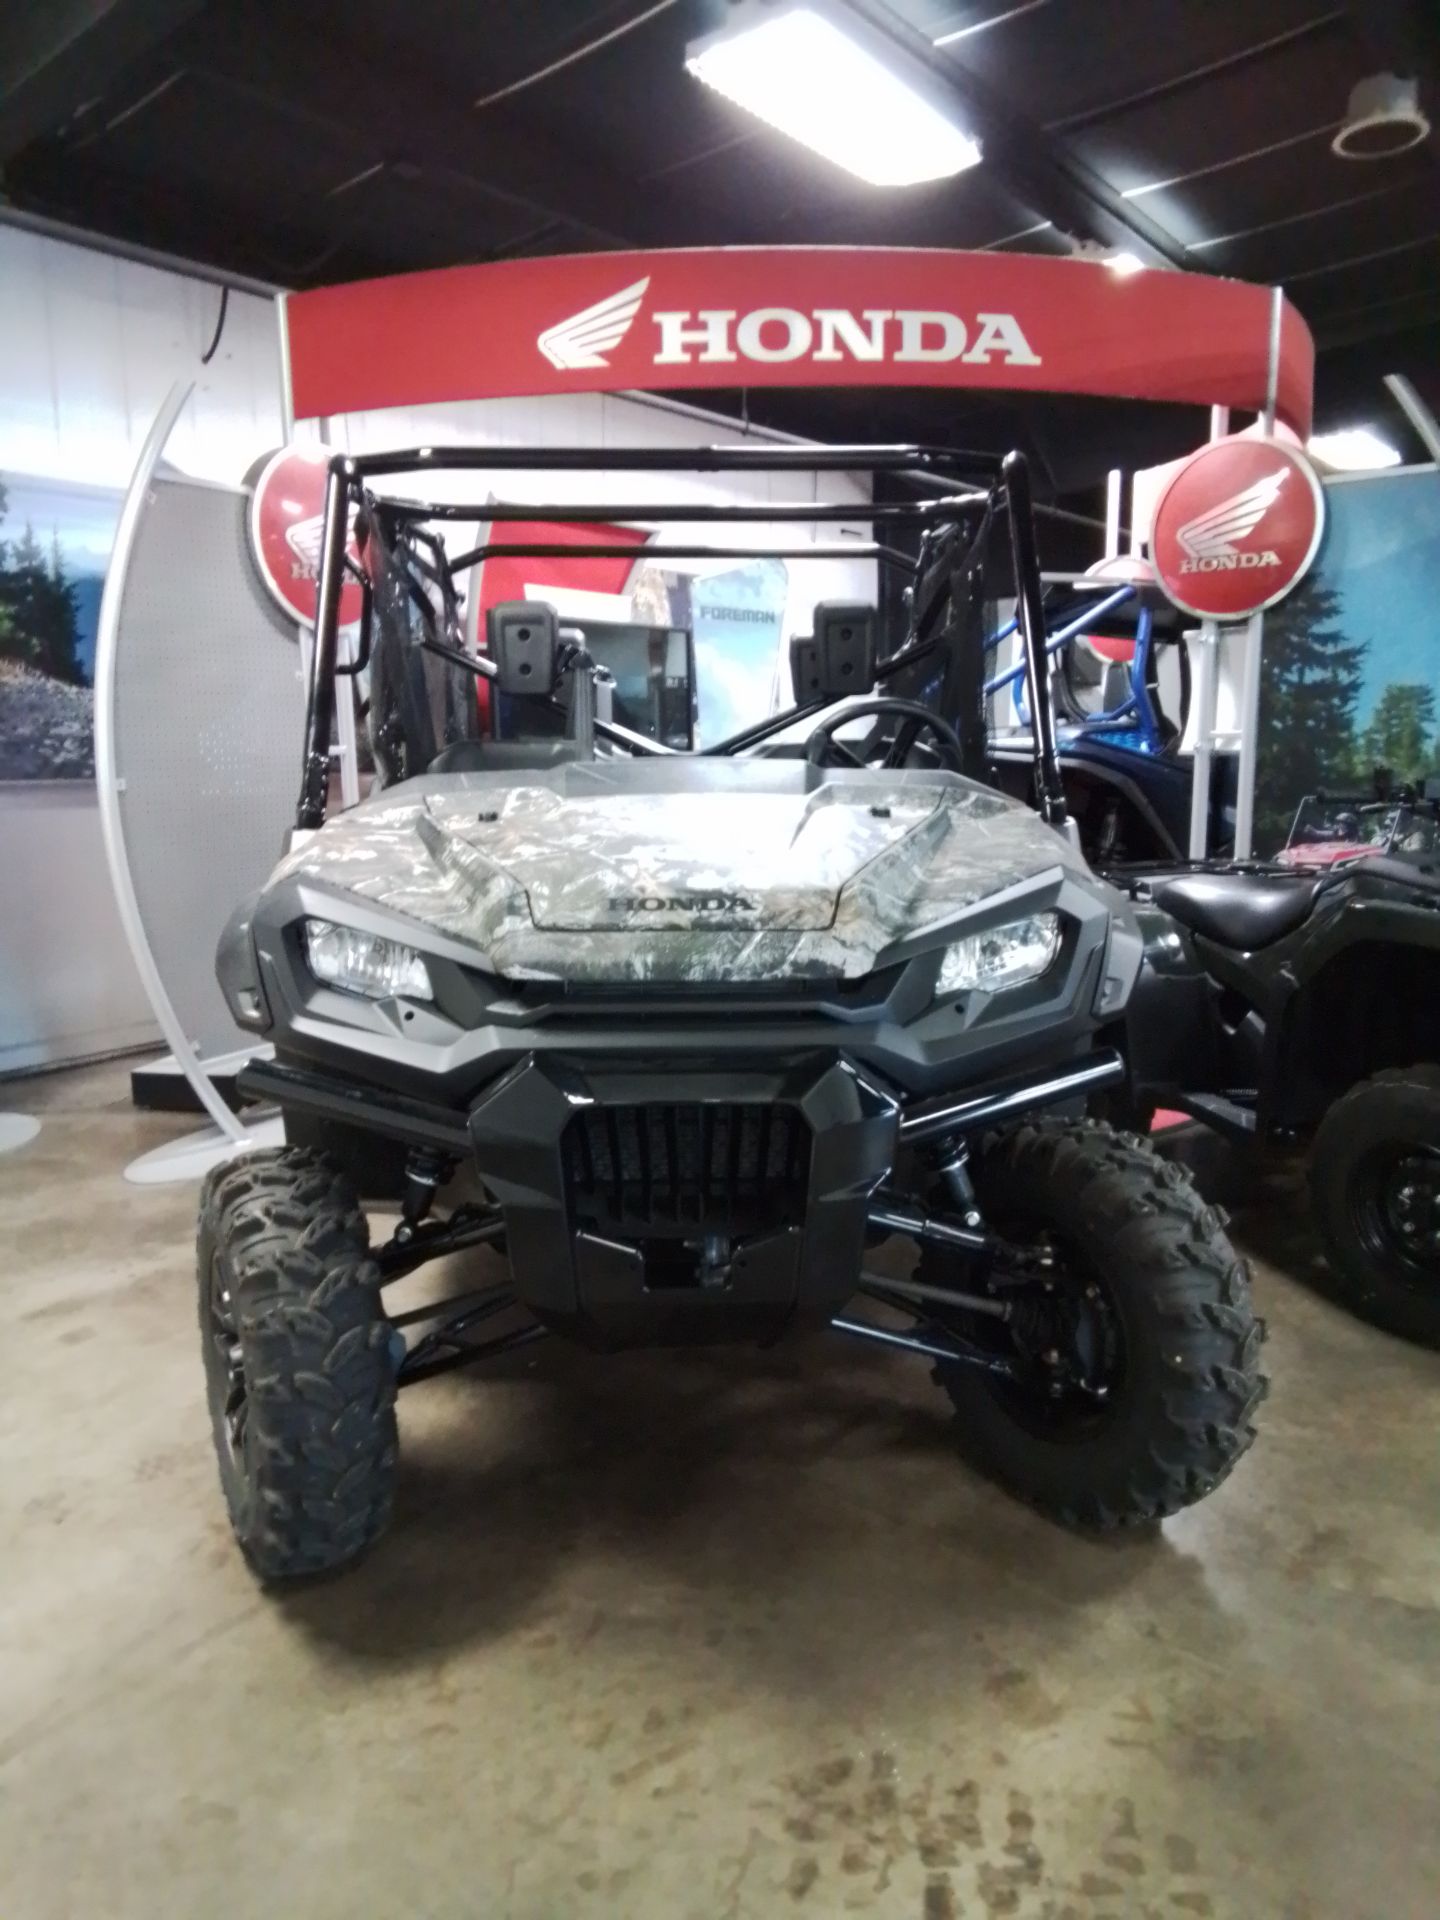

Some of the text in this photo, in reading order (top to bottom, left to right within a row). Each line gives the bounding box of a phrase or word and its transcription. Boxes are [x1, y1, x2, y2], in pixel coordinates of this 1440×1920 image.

[651, 307, 1043, 367] HONDA
[1179, 550, 1282, 574] HONDA
[700, 605, 776, 624] FOREMAN
[608, 896, 759, 911] HONDA
